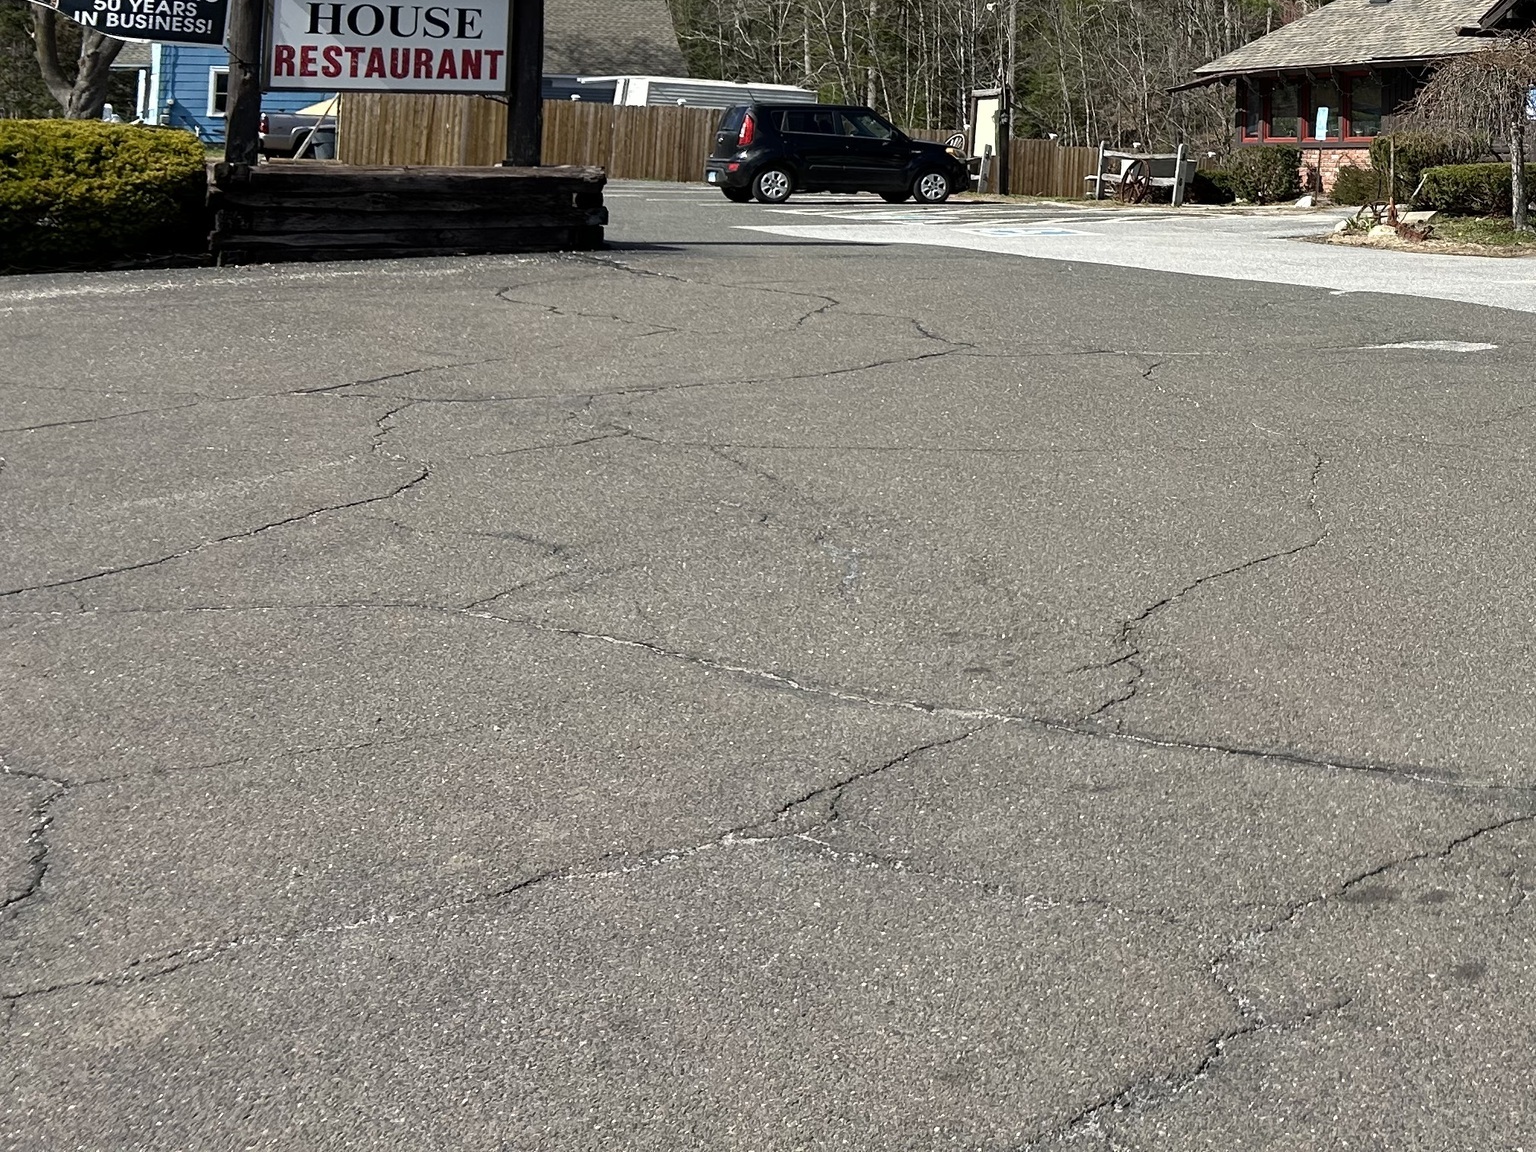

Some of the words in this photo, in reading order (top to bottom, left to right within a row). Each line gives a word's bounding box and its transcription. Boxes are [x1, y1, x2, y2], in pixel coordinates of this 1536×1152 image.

[74, 10, 99, 27] IN
[106, 12, 213, 34] BUSINESS!
[304, 1, 484, 40] HOUSE
[273, 44, 505, 81] RESTAURANT
